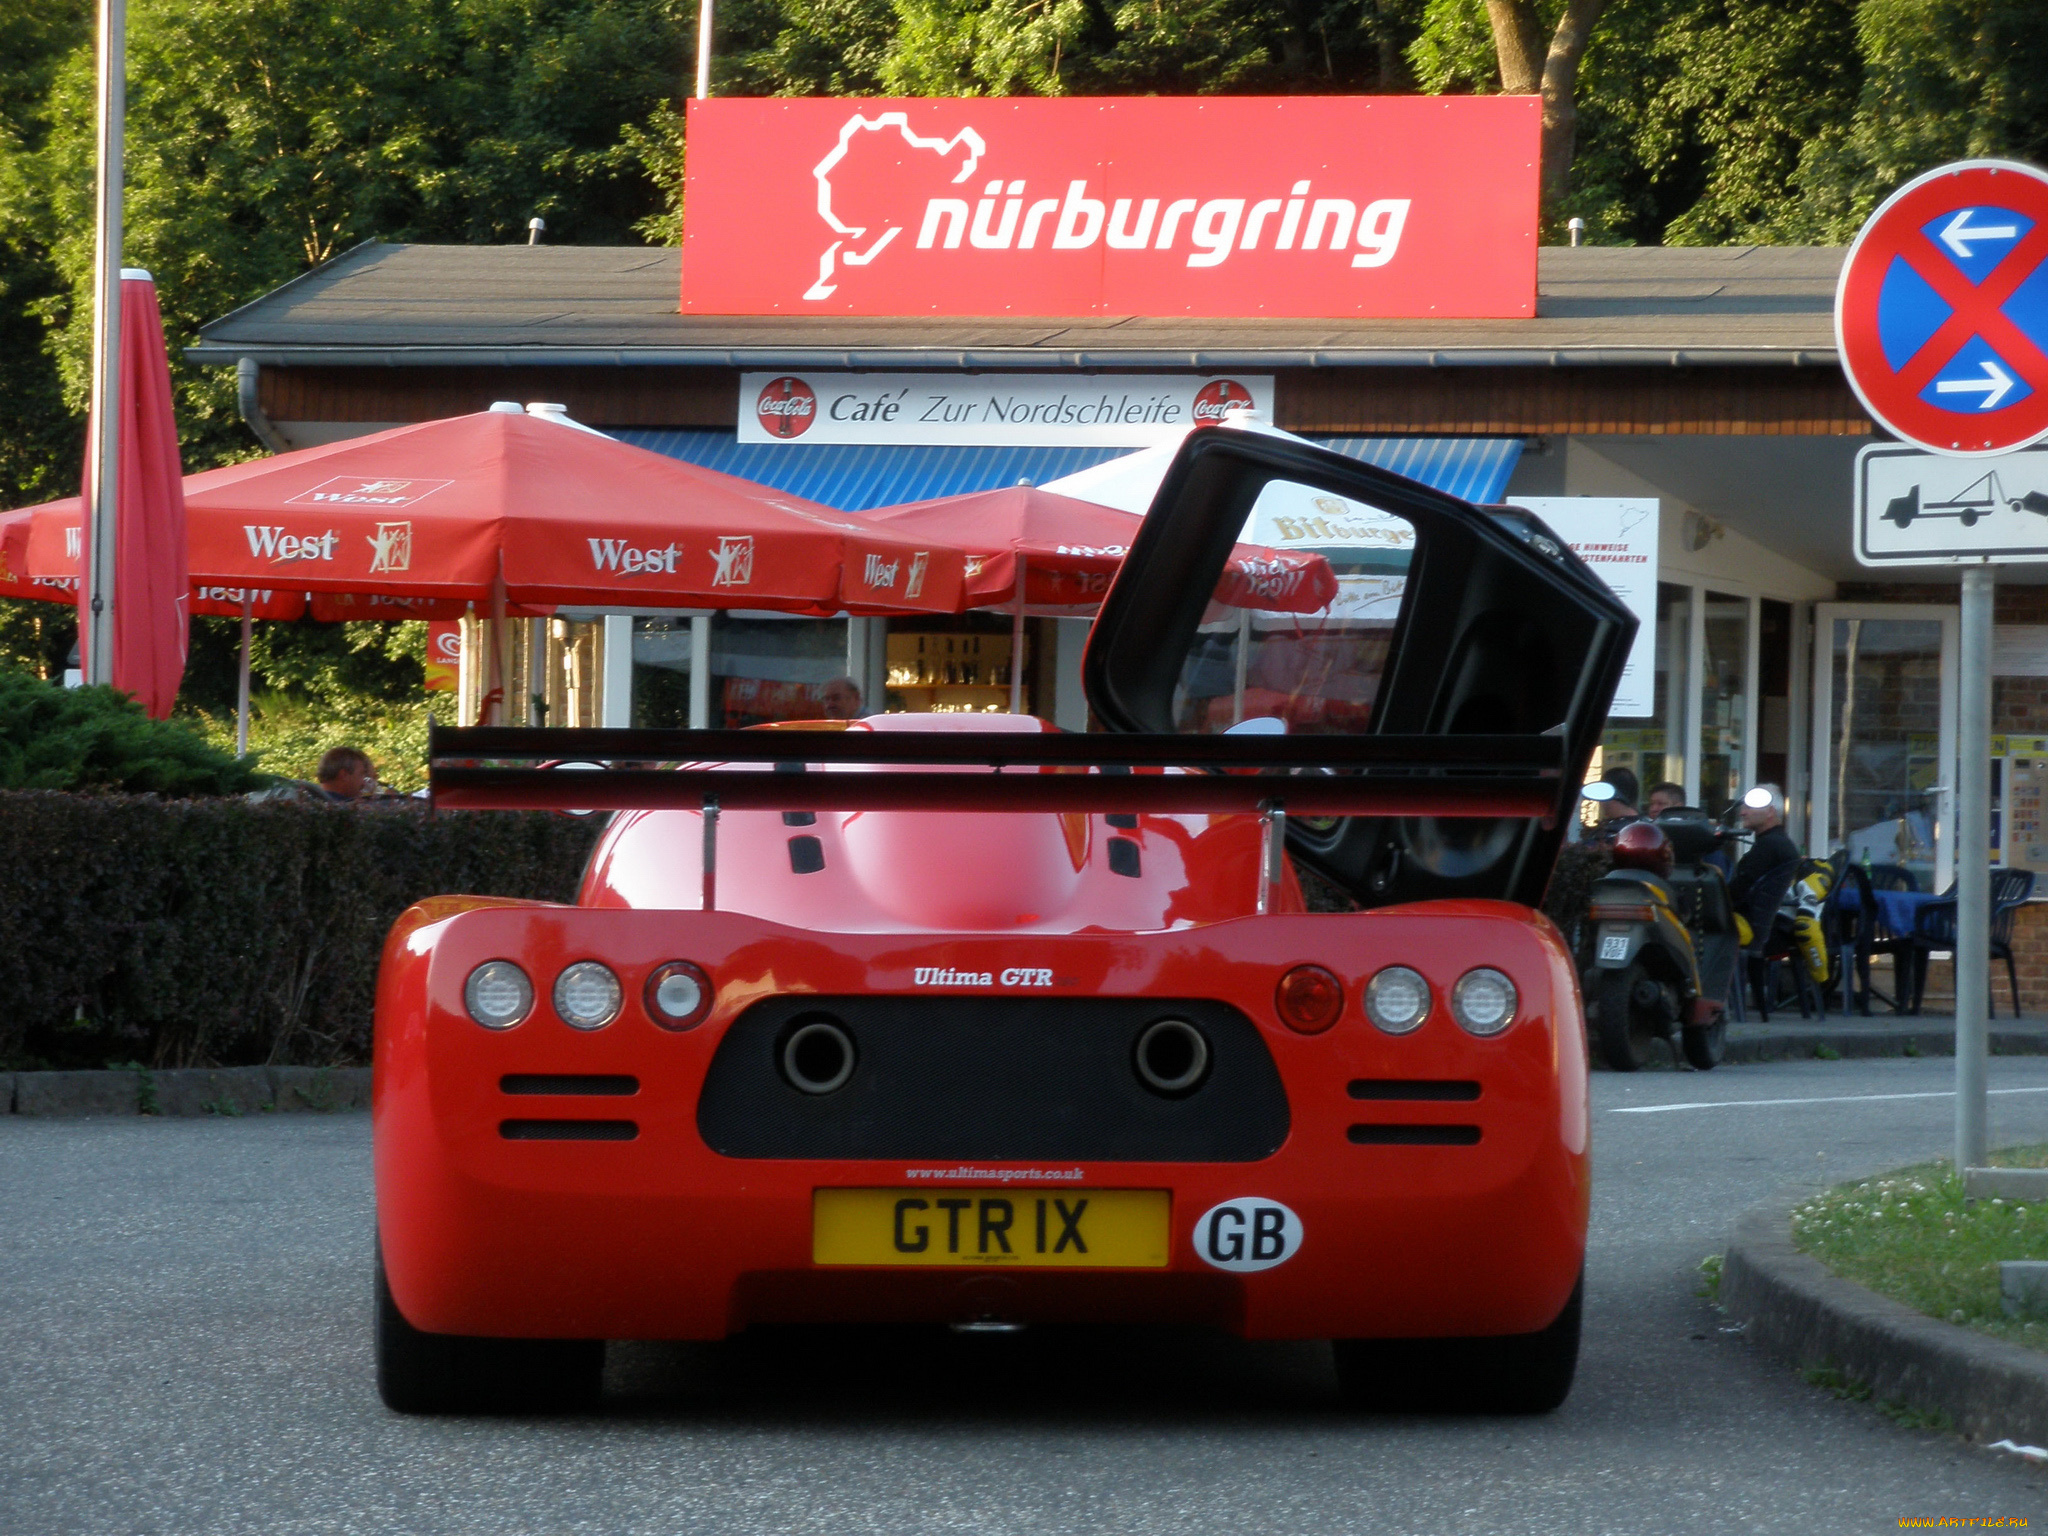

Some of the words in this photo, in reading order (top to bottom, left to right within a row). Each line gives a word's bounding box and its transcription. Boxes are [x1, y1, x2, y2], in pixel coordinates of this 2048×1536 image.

[916, 179, 1412, 268] nürburgring
[830, 388, 910, 423] Café
[919, 396, 986, 422] Zur
[988, 394, 1181, 425] Nordschleife
[243, 524, 338, 562] West
[587, 537, 682, 575] West
[1580, 554, 1648, 563] STENFAHRTEN
[863, 552, 899, 588] West
[914, 967, 993, 986] Ultima
[1000, 968, 1053, 986] GTR
[906, 1167, 1083, 1182] www.ultimasports.co.uk
[893, 1198, 1013, 1253] GTR
[1208, 1206, 1286, 1262] GB
